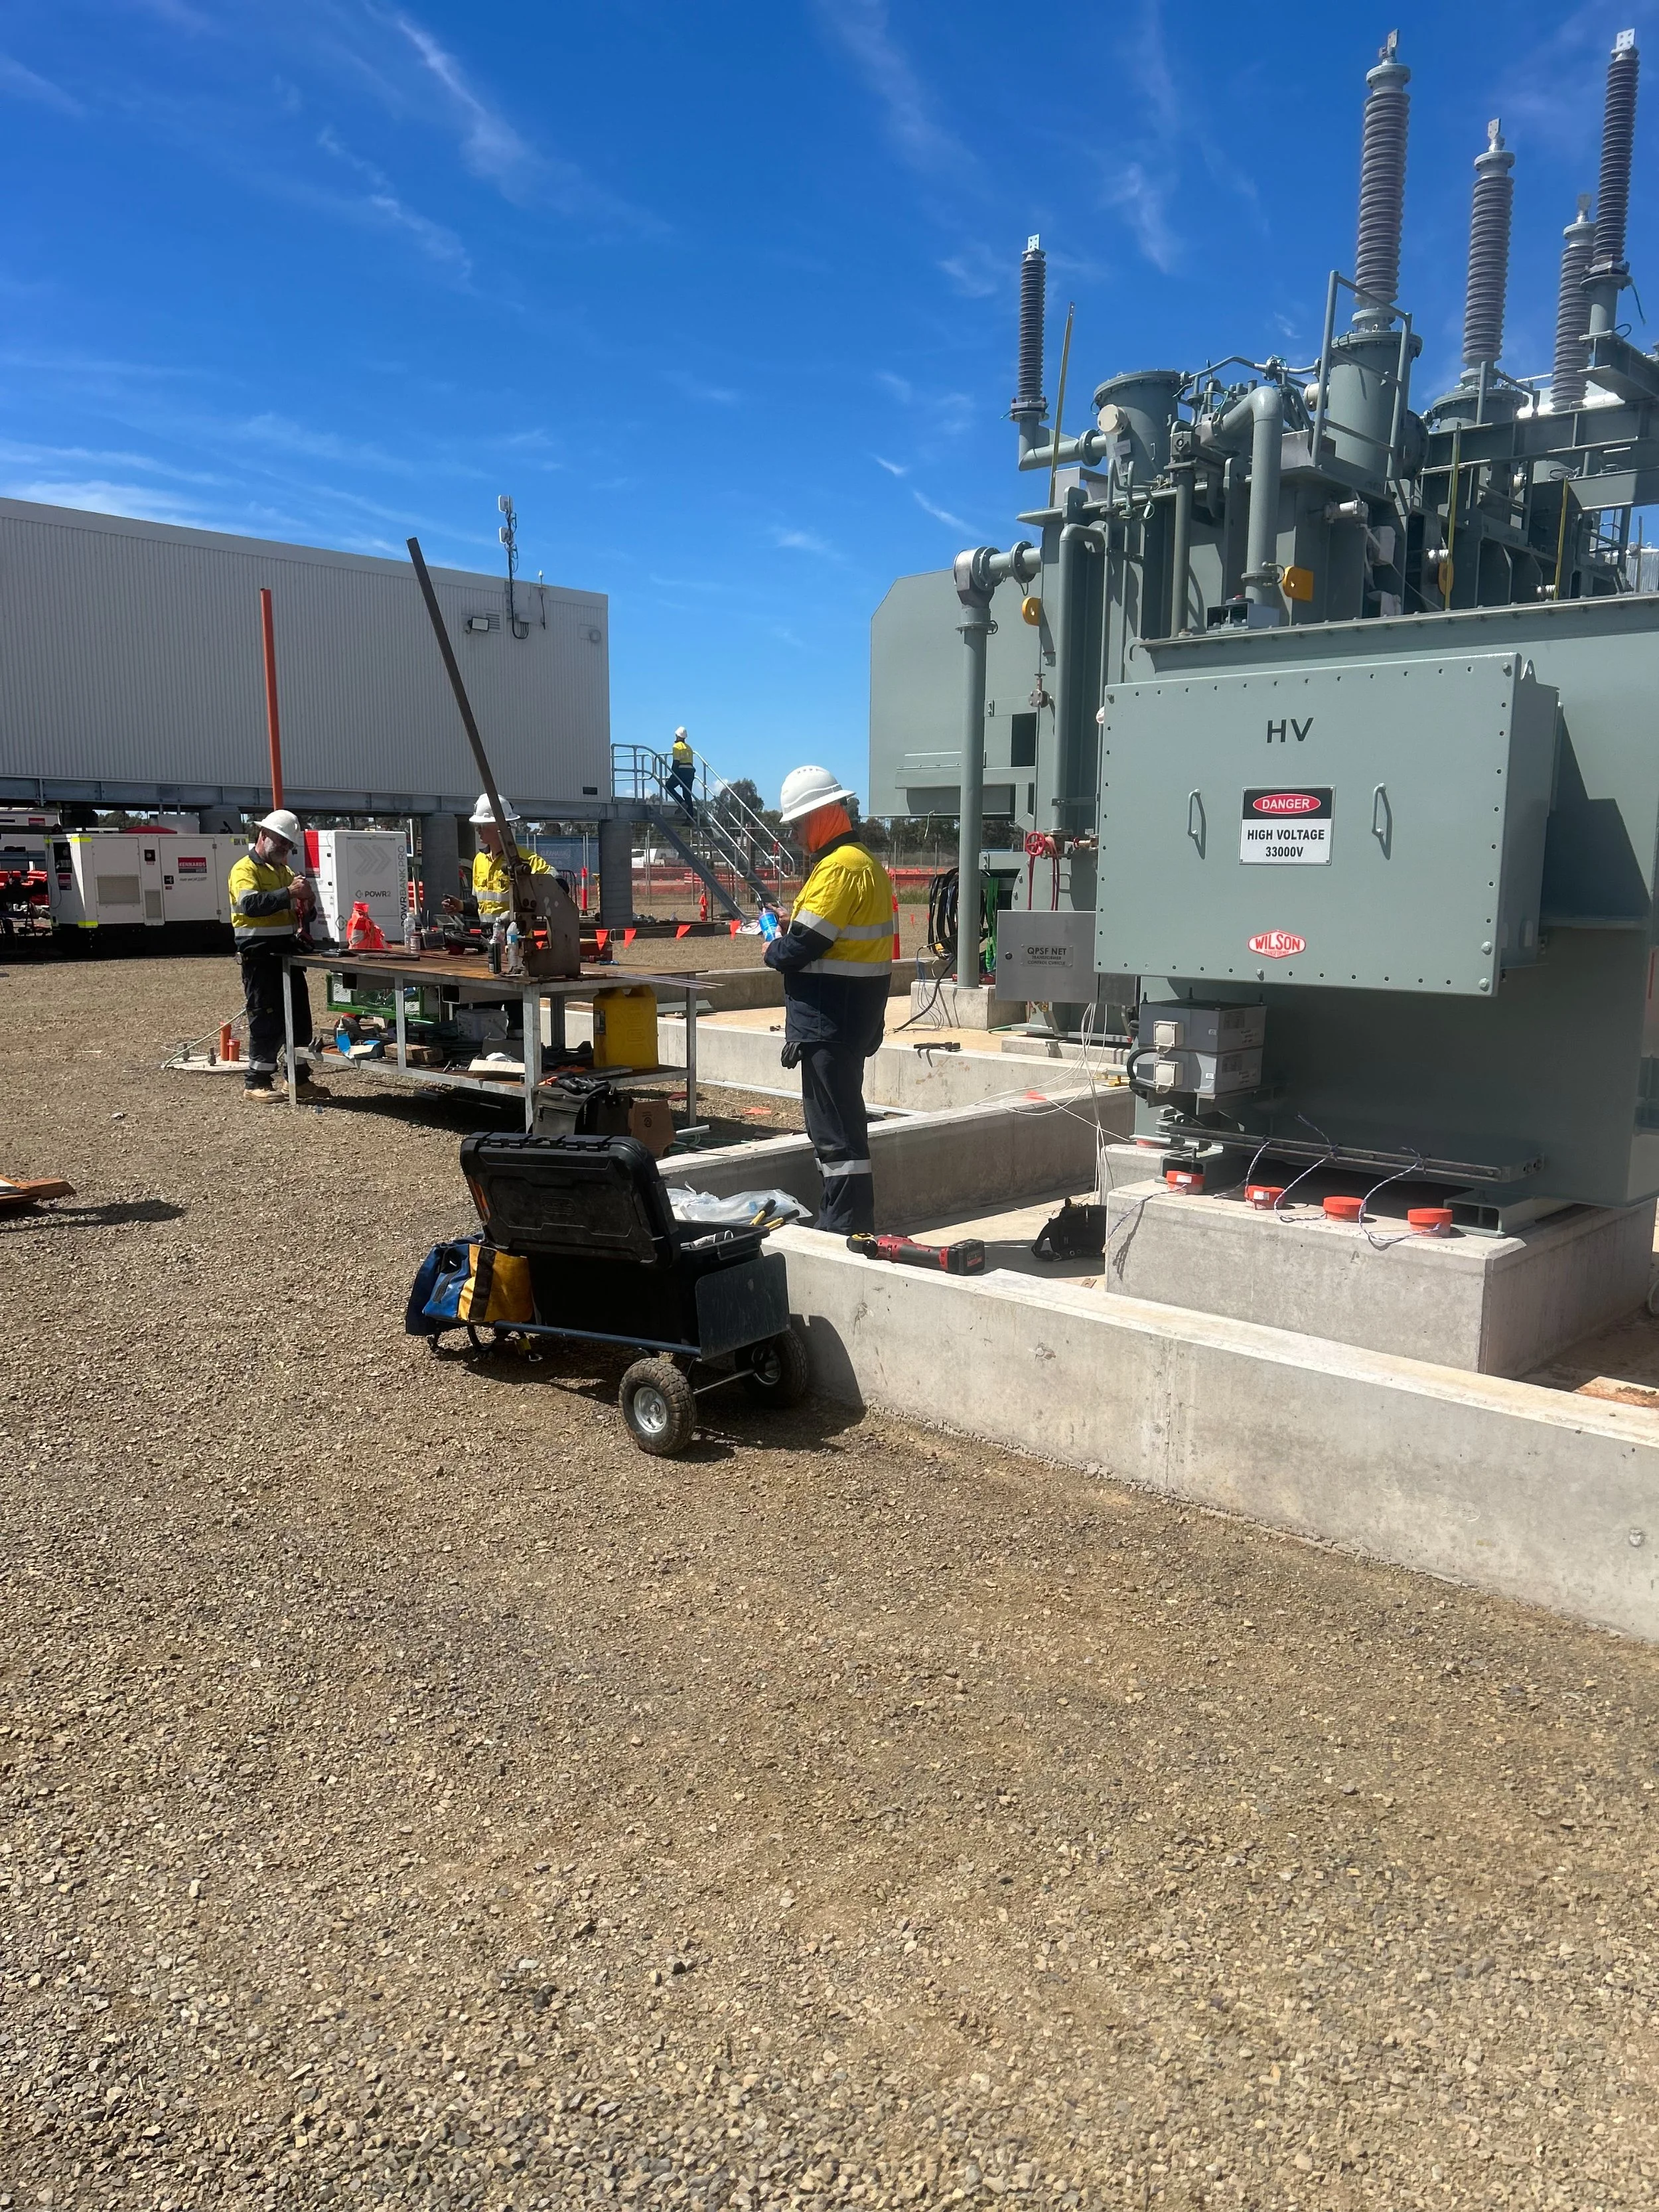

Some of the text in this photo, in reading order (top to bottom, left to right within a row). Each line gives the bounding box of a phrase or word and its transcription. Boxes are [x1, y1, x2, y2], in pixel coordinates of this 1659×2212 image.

[1267, 717, 1314, 743] HV
[1262, 798, 1310, 809] DANGER
[1248, 830, 1325, 840] HIGH VOLTAGE
[1265, 846, 1303, 857] 33000V
[1256, 934, 1300, 950] WILSON
